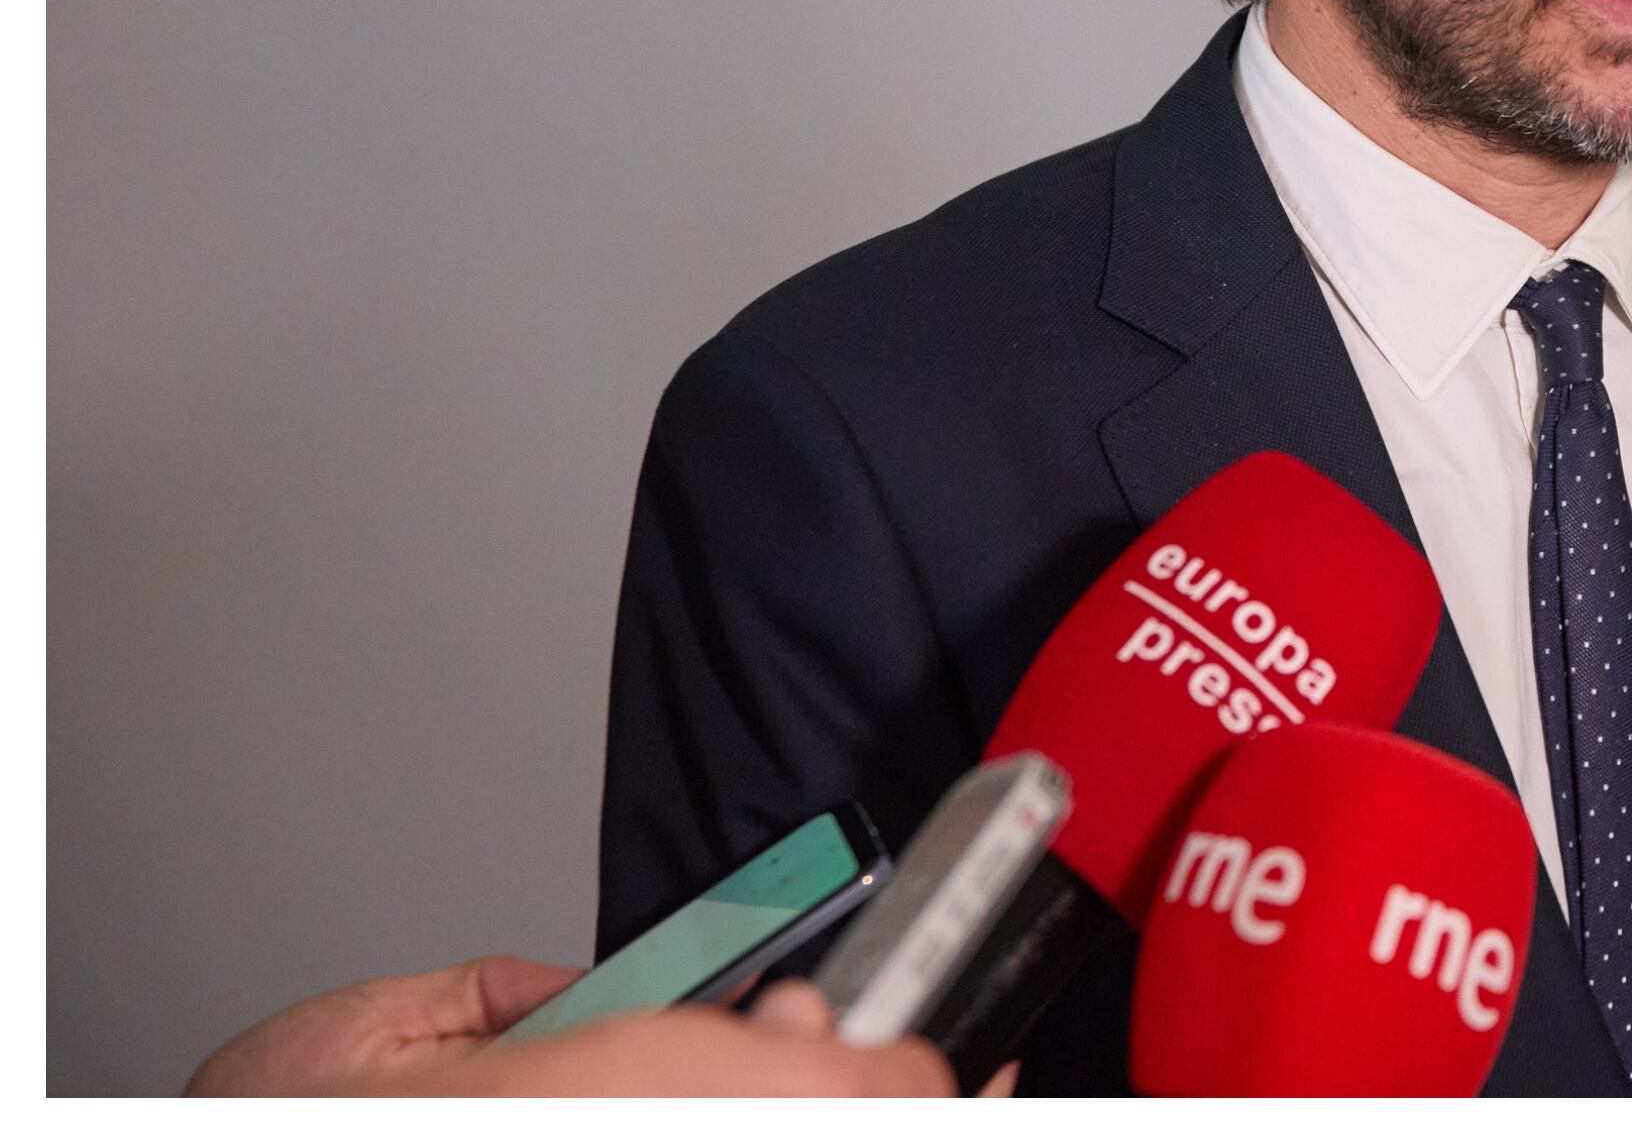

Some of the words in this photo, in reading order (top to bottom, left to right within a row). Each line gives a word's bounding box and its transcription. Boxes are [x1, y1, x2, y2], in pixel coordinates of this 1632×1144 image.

[1147, 544, 1337, 706] europa
[1166, 832, 1306, 945] rne
[1370, 885, 1515, 1032] rne
